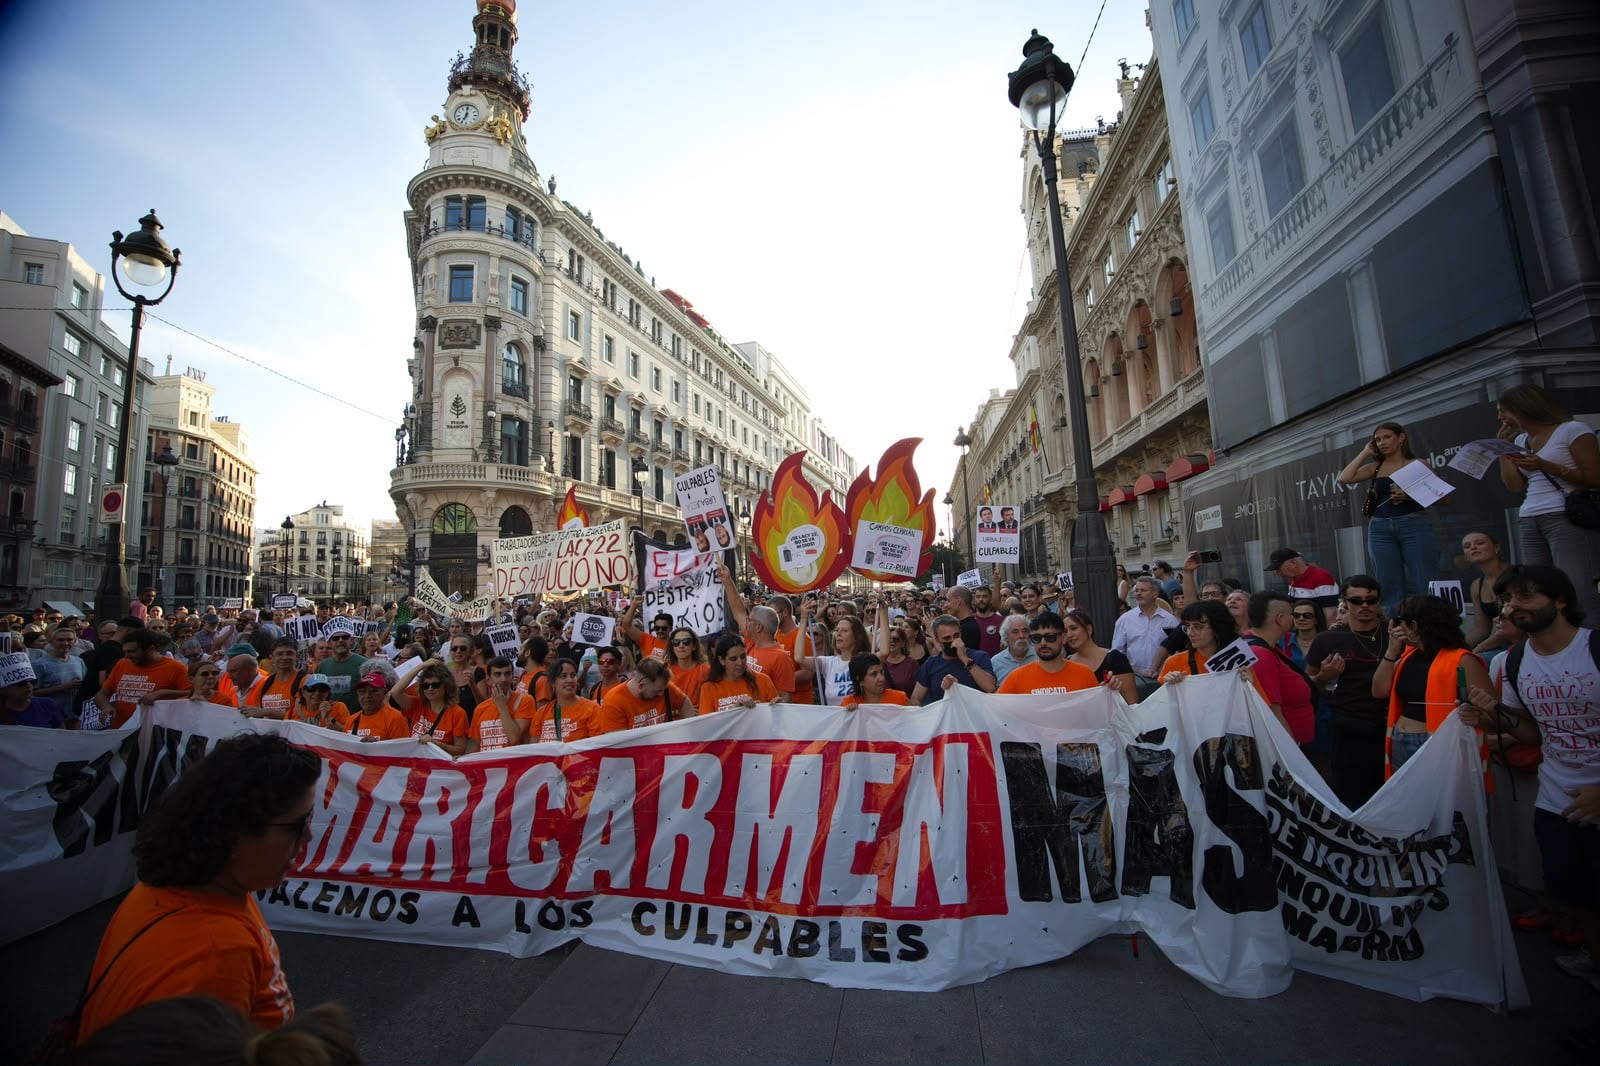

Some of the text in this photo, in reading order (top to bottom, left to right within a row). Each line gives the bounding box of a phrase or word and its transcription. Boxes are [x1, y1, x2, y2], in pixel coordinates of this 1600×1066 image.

[676, 469, 715, 492] CULPABLES
[556, 539, 595, 560] LACY
[594, 533, 622, 555] 22
[978, 546, 1018, 557] CULPABLES
[496, 554, 629, 598] DESAHUCIO NO
[653, 550, 693, 578] EL
[416, 588, 447, 614] NUESTRA
[303, 619, 318, 639] NO
[491, 629, 516, 645] DERECHO
[583, 621, 605, 631] STOP
[1031, 686, 1067, 696] SINDICATO
[297, 742, 969, 908] MARICARMEN
[1000, 726, 1279, 914] MÁS
[1267, 804, 1299, 850] DE
[255, 881, 929, 963] ALEMOS A LOS CULPABLES
